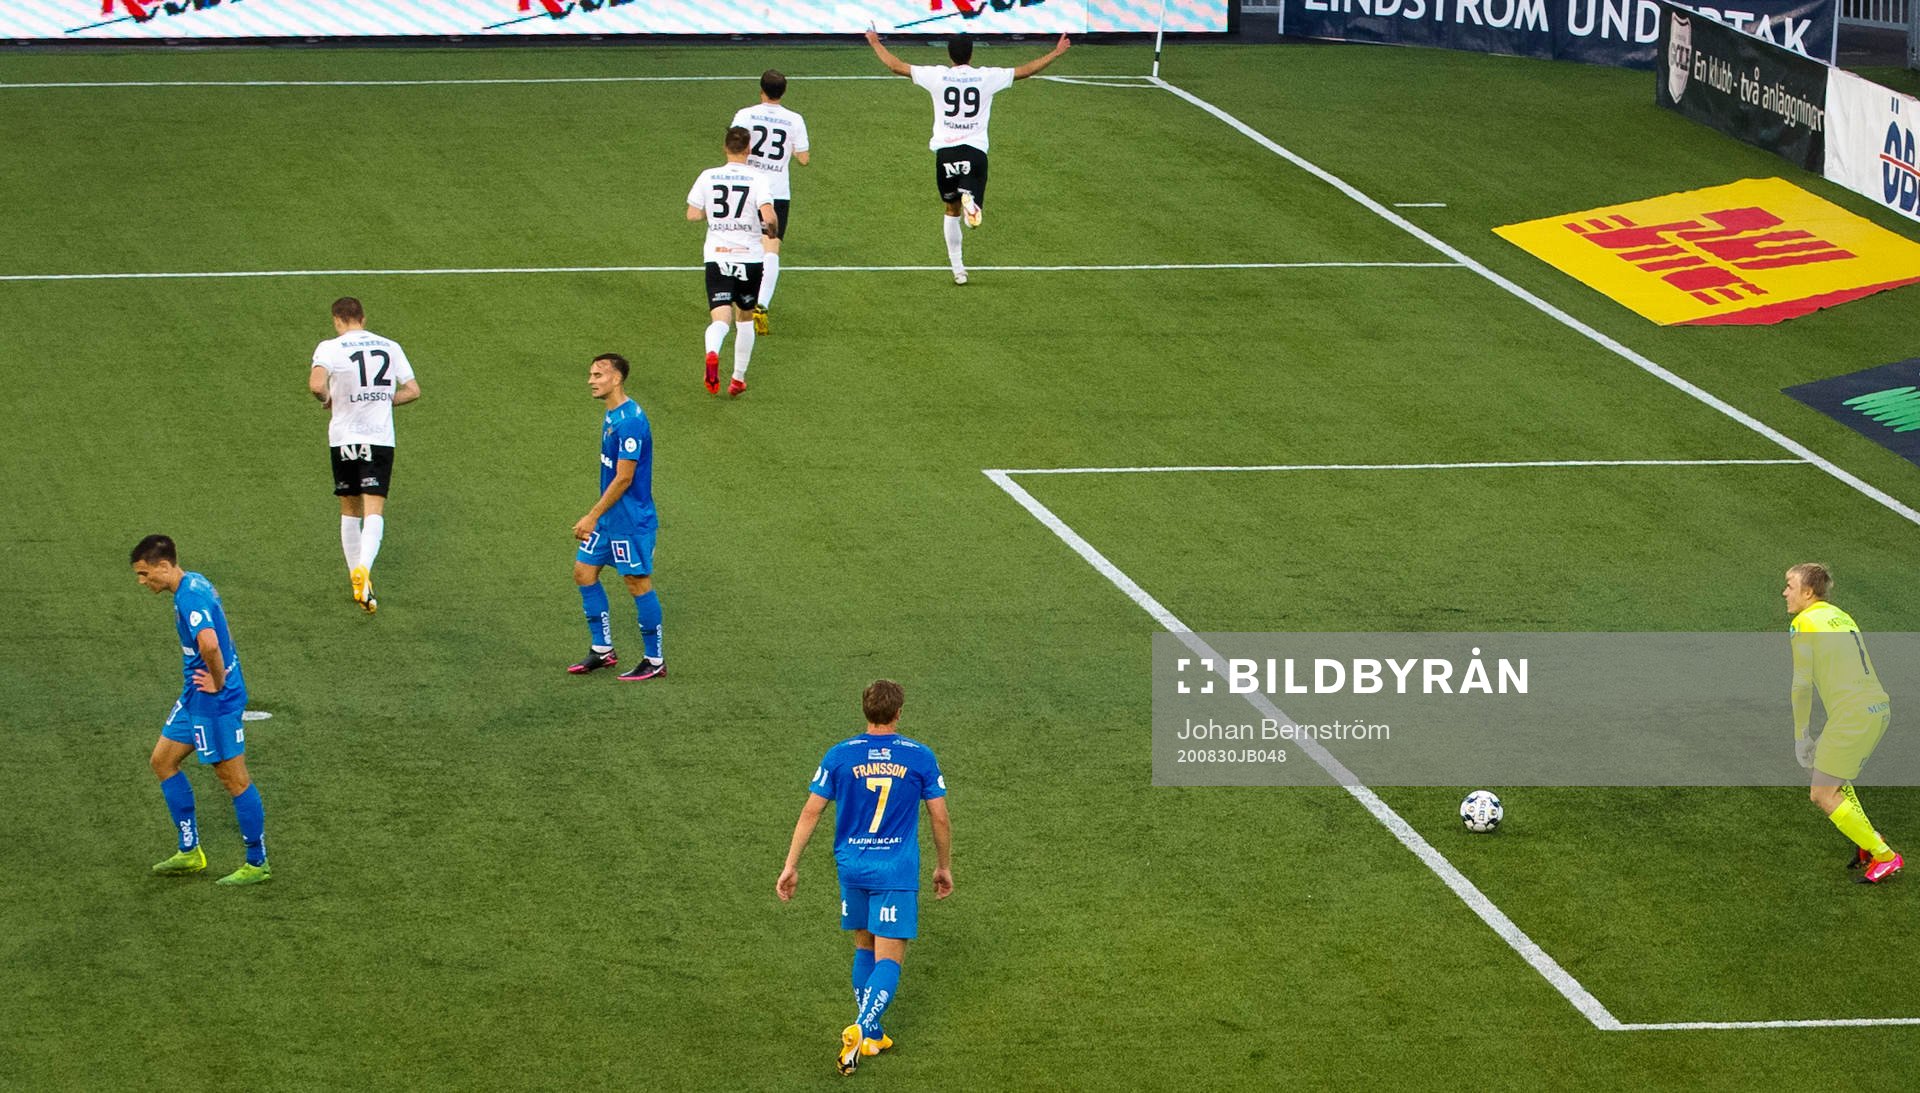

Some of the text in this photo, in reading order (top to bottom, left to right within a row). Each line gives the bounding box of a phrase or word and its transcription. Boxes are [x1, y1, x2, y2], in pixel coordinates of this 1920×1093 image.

[1566, 0, 1812, 58] UNDTAK
[1694, 50, 1707, 82] En
[1708, 55, 1733, 95] klubb
[1740, 66, 1760, 106] två
[943, 86, 981, 118] 99
[751, 125, 787, 161] 23
[1882, 96, 1920, 217] ÖB
[712, 184, 751, 219] 37
[349, 349, 392, 388] 12
[350, 391, 394, 403] LARSSON
[340, 444, 374, 462] NA
[852, 762, 908, 779] FRANSSON
[866, 777, 893, 833] 7
[848, 837, 903, 845] PLATINUMCARS
[879, 905, 898, 923] nt
